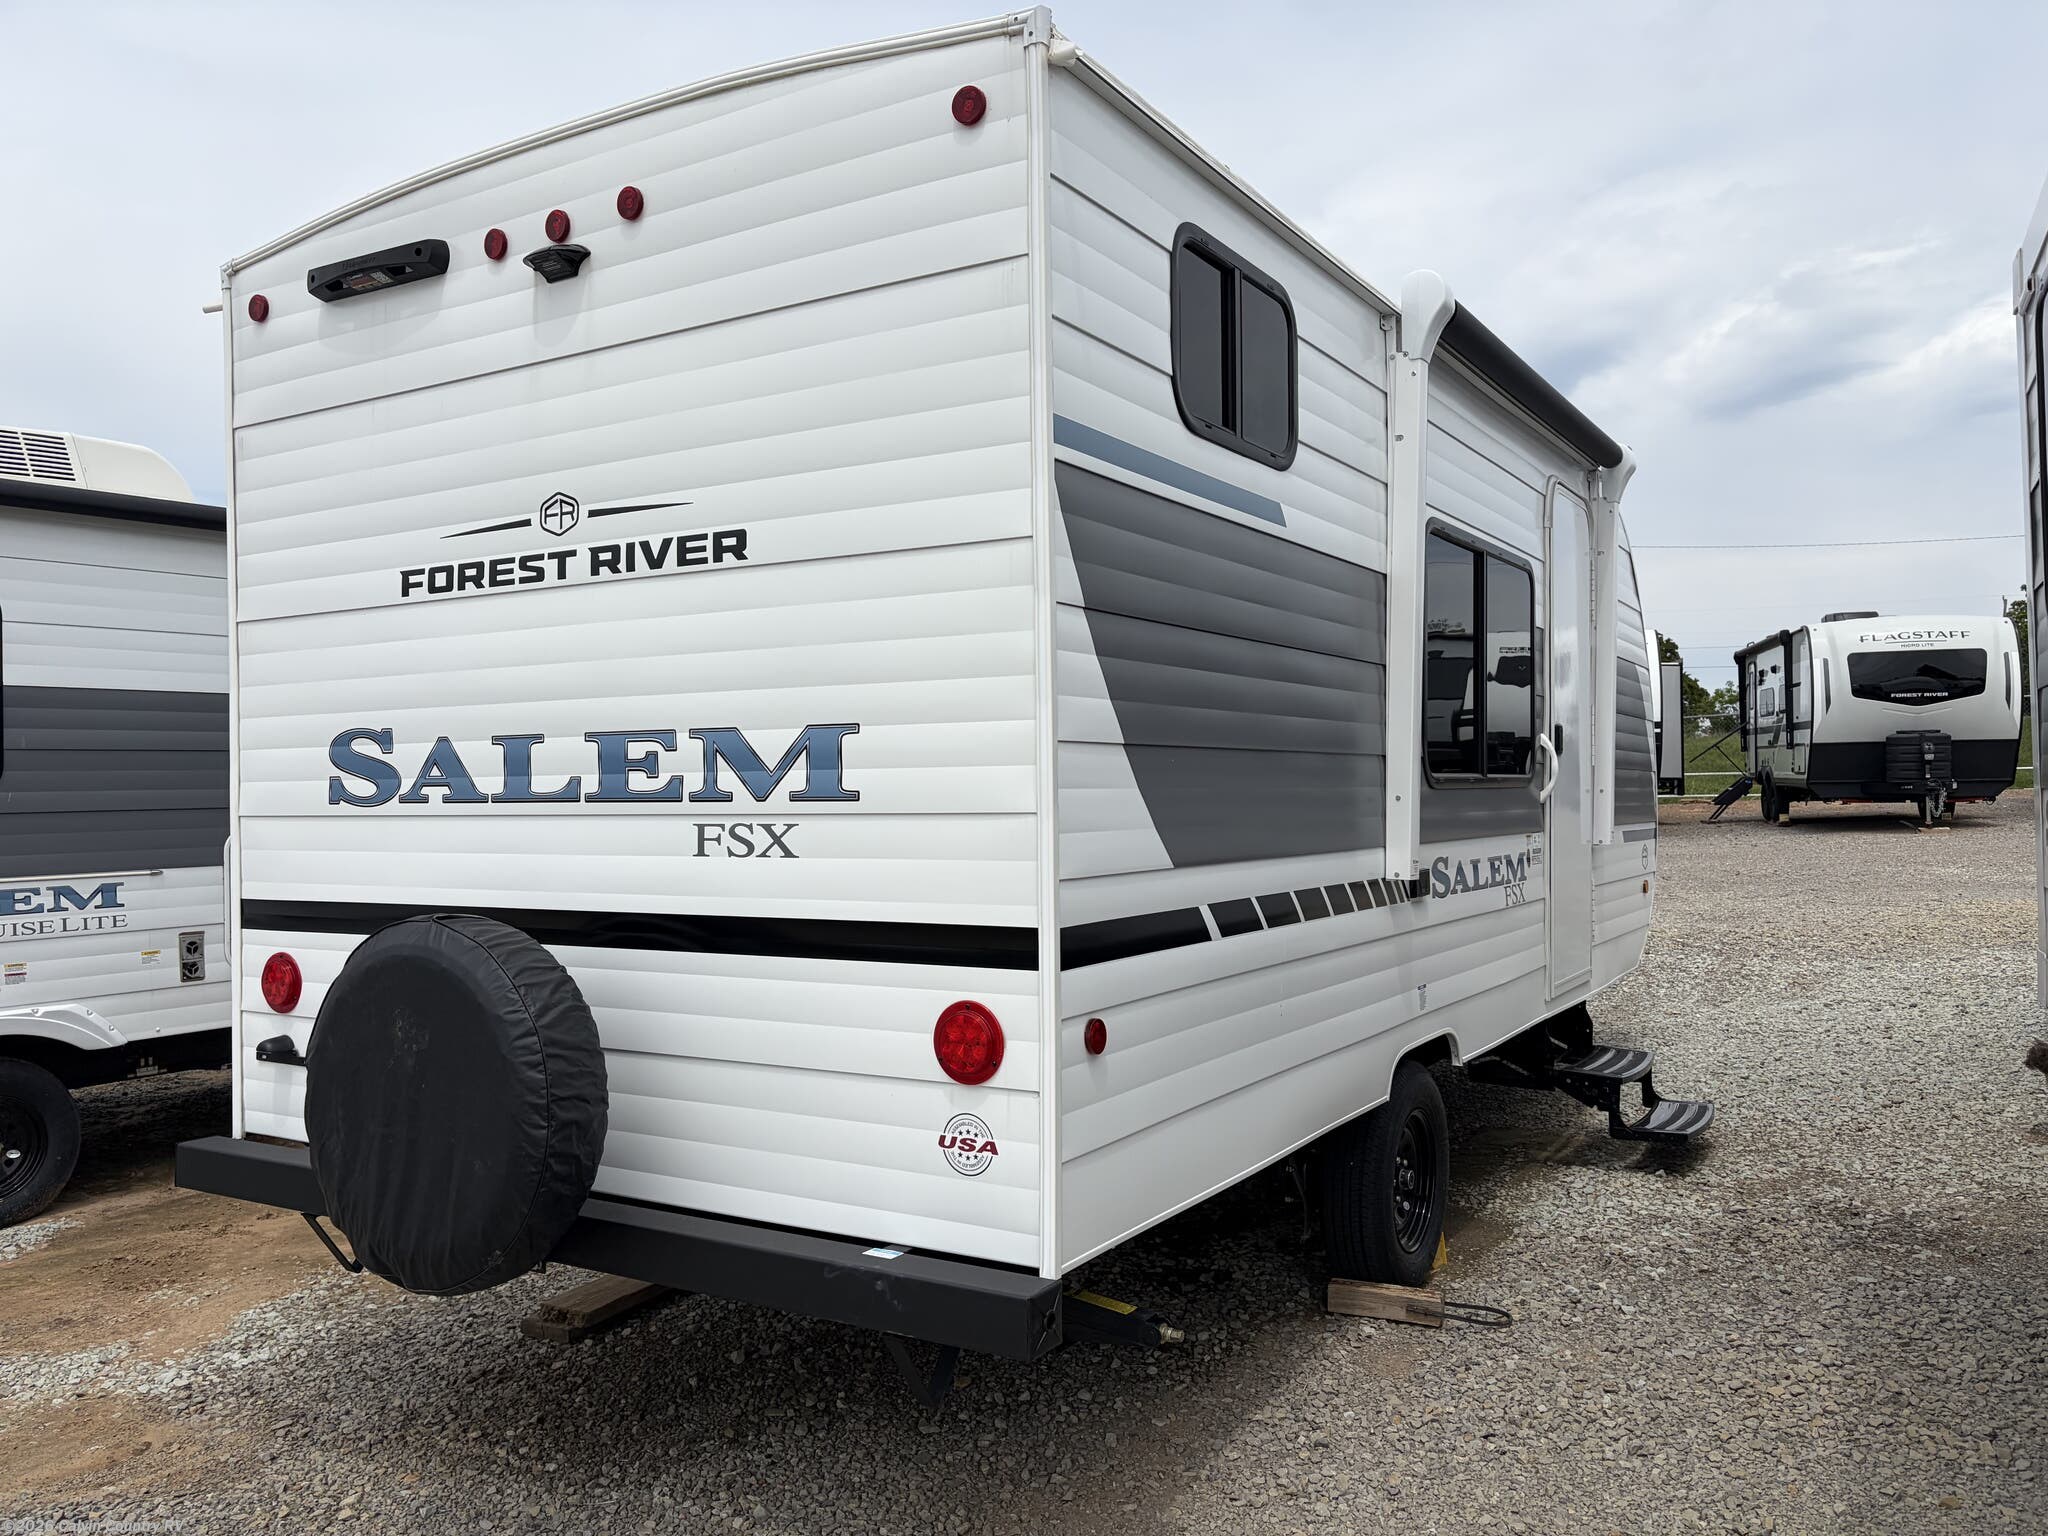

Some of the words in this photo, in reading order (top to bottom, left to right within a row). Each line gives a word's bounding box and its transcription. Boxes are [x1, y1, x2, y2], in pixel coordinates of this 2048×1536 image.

[400, 549, 577, 598] FOREST
[588, 528, 748, 577] RIVER
[1859, 630, 1971, 643] FLAGSTAFF
[328, 723, 860, 807] SALEM
[692, 823, 800, 859] FSX
[1431, 851, 1527, 899] SALEM
[1503, 882, 1526, 907] FSX
[60, 914, 129, 933] LITE
[938, 1134, 999, 1156] USA
